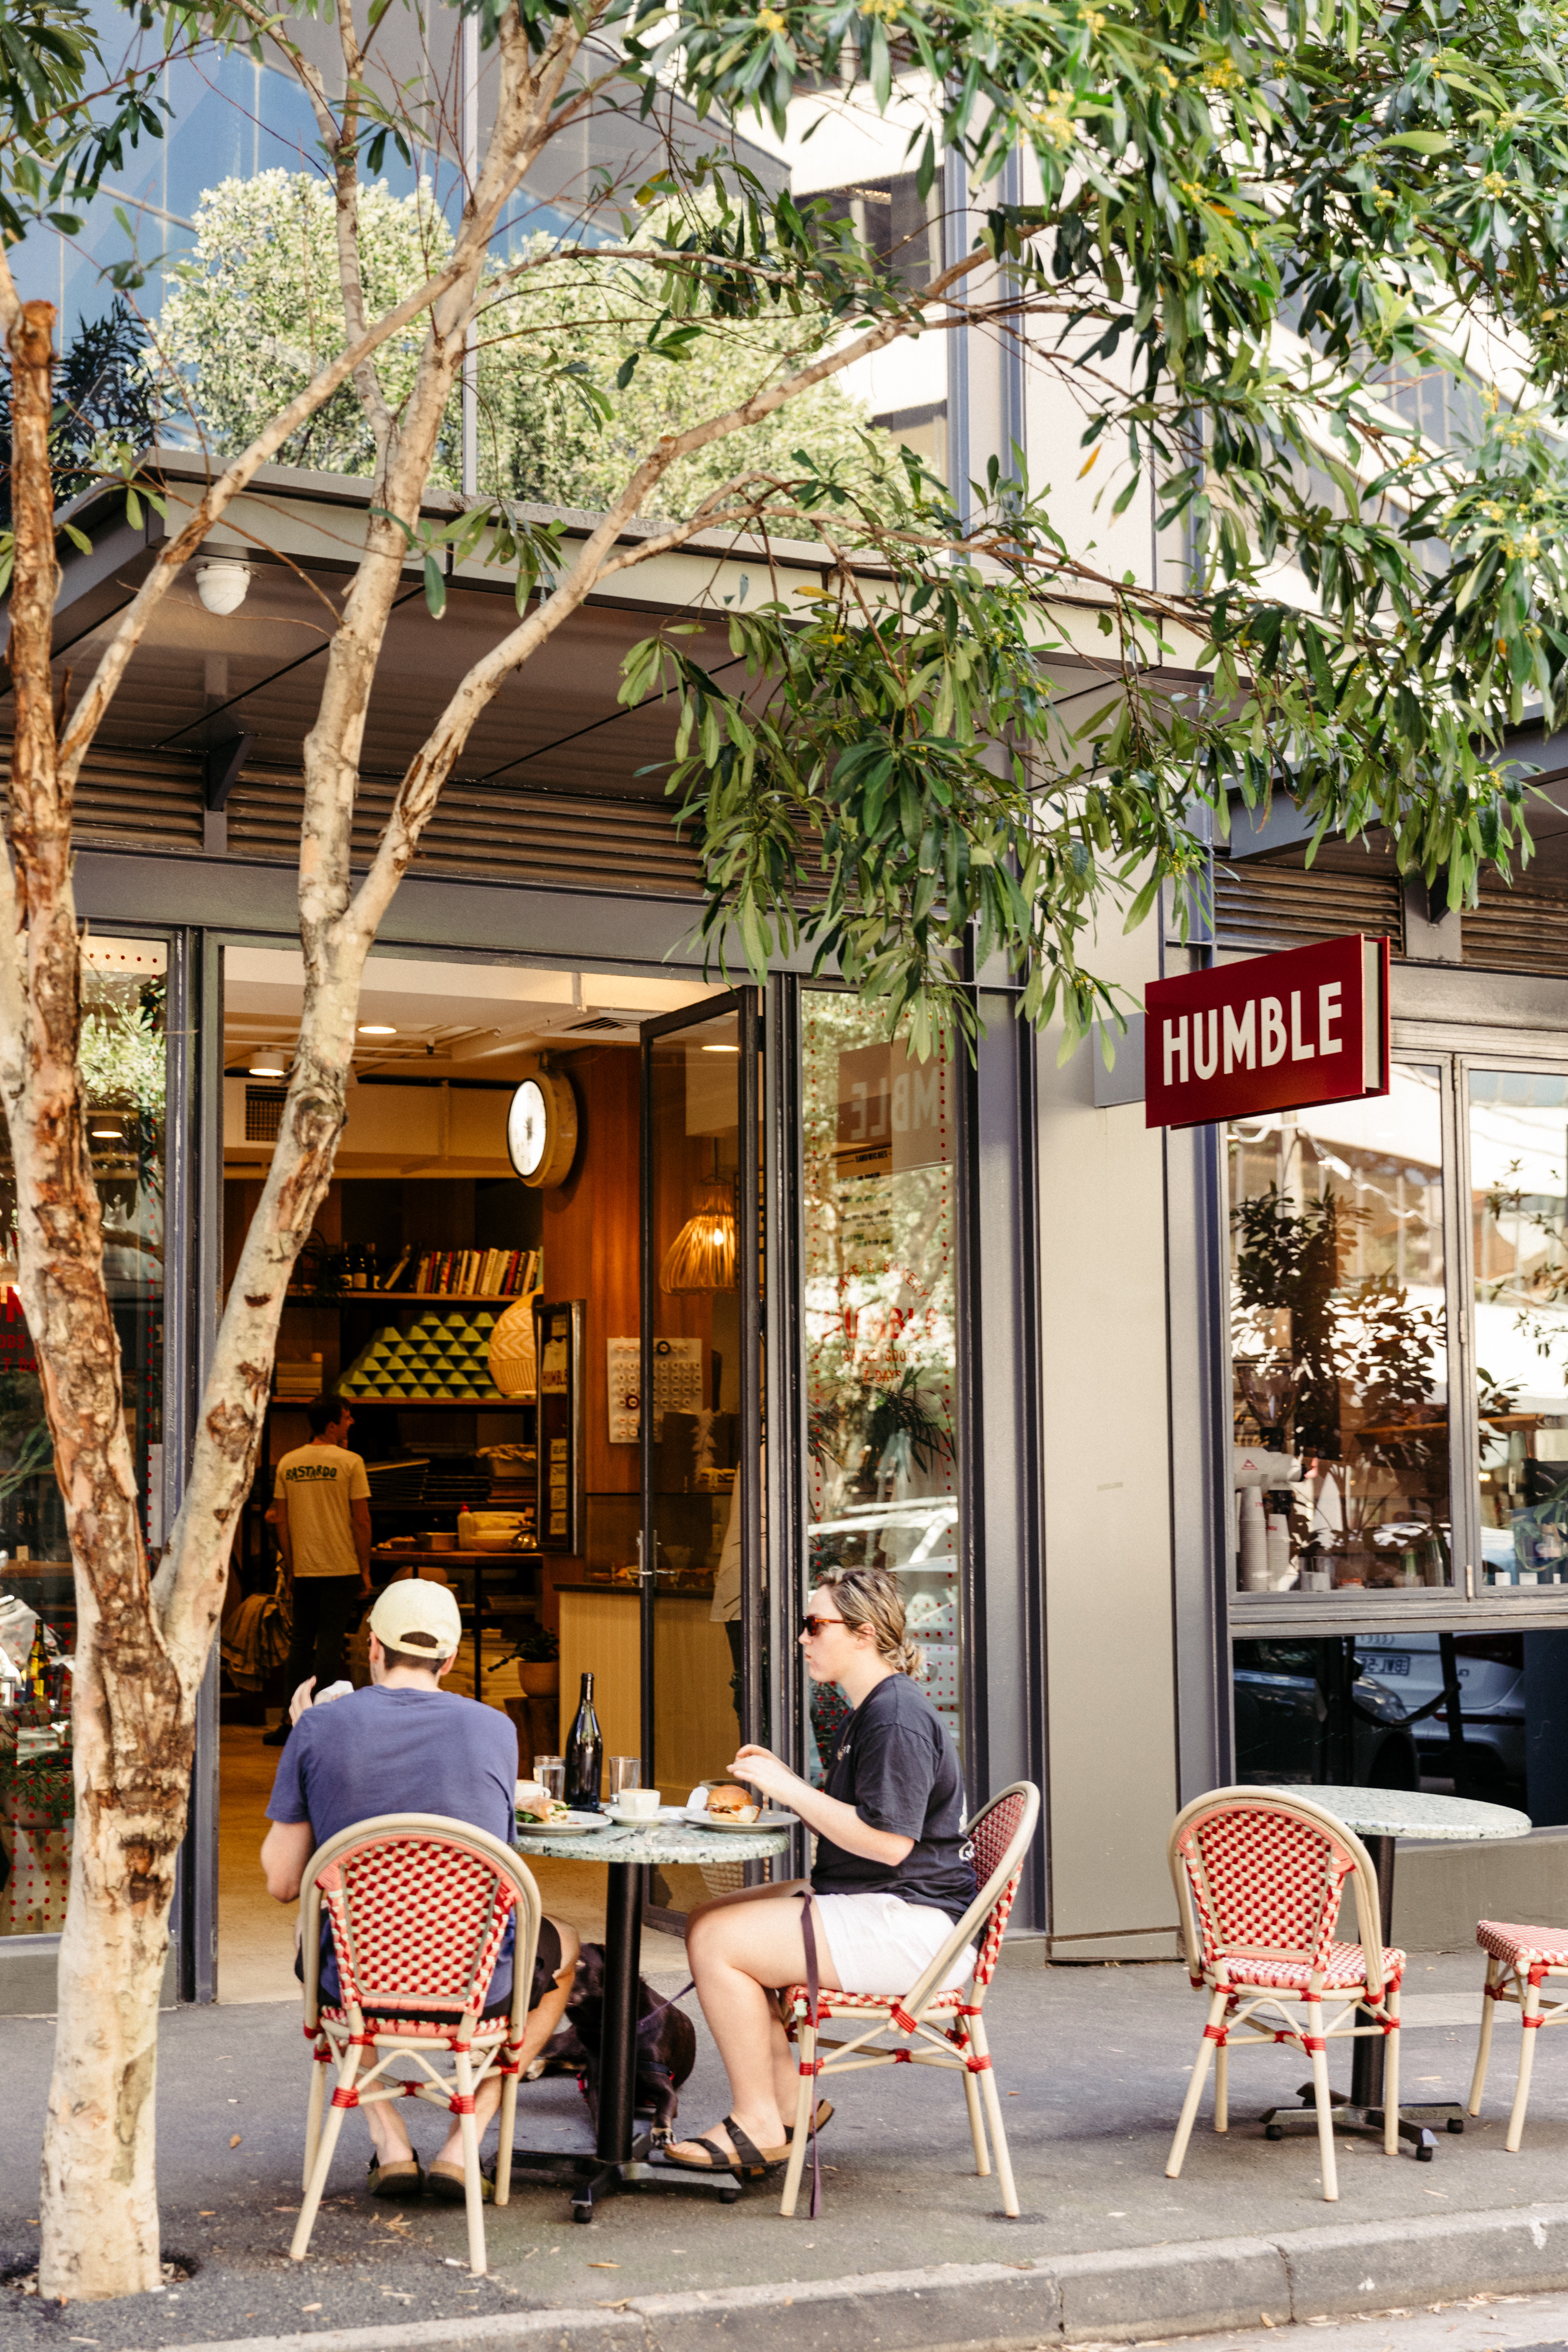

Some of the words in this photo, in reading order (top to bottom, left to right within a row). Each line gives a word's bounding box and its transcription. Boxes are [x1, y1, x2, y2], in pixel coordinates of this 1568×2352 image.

[1163, 981, 1342, 1086] HUMBLE
[855, 1150, 888, 1162] SANDWICHES
[883, 1259, 930, 1298] BAKERY
[824, 1307, 938, 1339] HUMBLE
[3, 1357, 11, 1372] 7
[863, 1369, 870, 1382] 7
[875, 1369, 902, 1382] DAYS
[286, 1465, 337, 1481] BASTARDO
